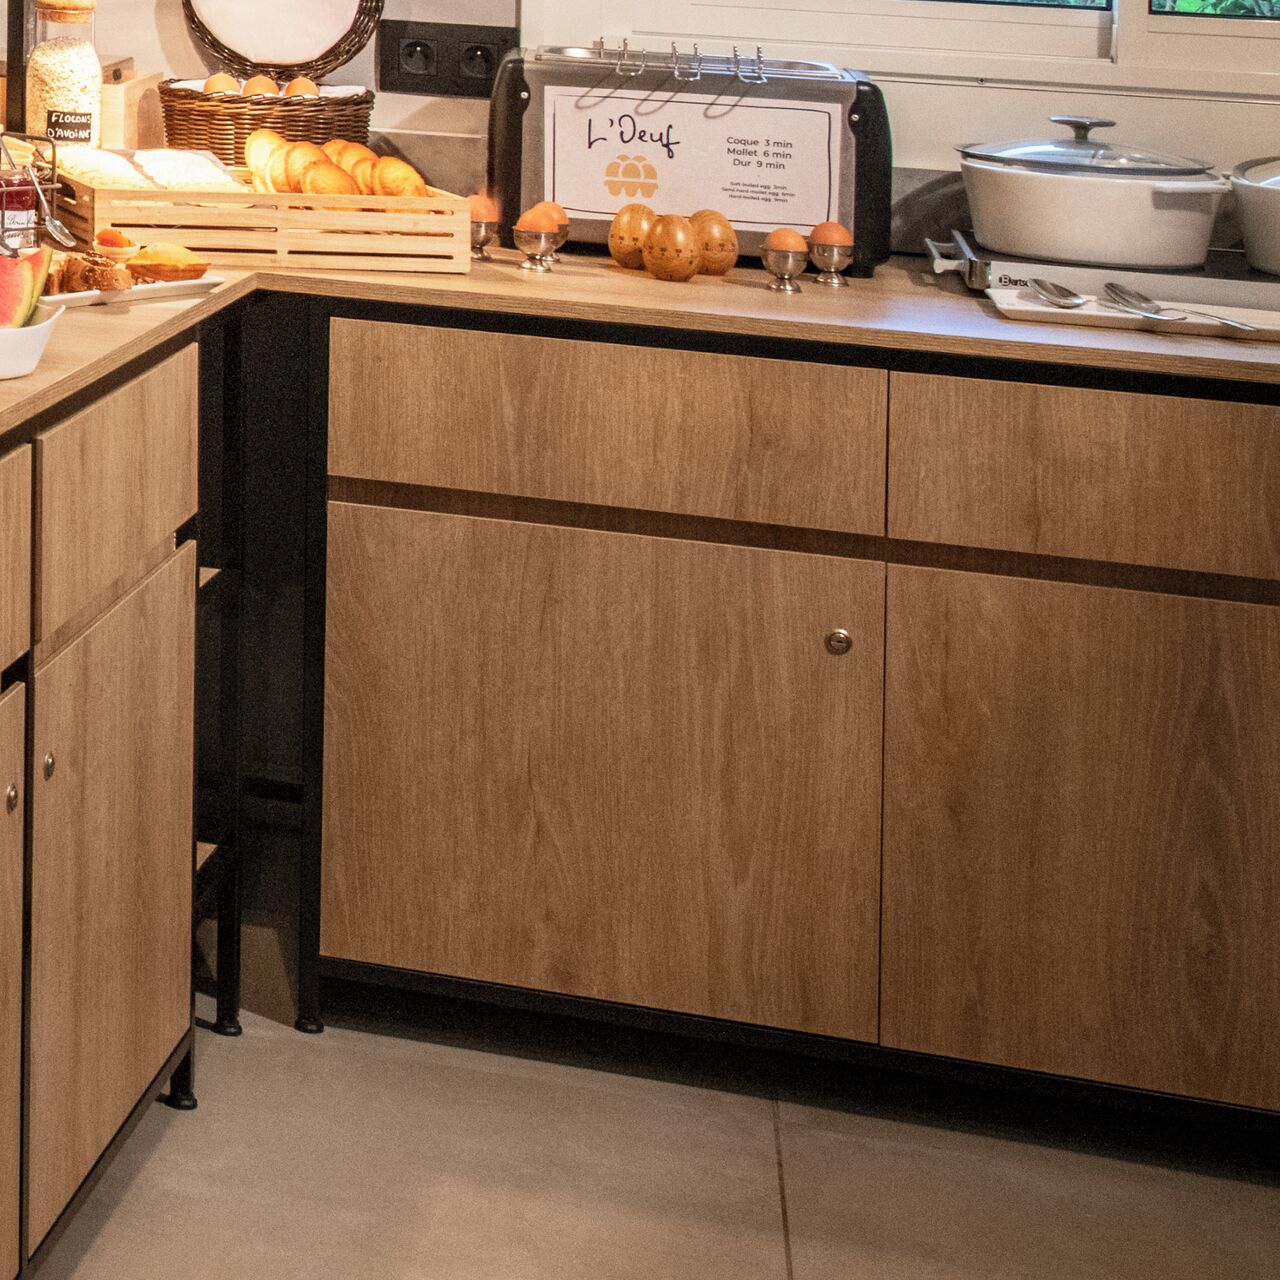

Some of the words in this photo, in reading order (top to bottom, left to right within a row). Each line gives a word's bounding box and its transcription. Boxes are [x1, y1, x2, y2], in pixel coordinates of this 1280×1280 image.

[51, 112, 91, 123] FLOCONS
[726, 136, 759, 147] Coque
[764, 139, 770, 147] 3
[773, 140, 793, 149] min
[726, 147, 757, 157] Mollet
[763, 150, 770, 158] 6
[772, 151, 792, 159] min
[733, 158, 751, 167] Dur
[756, 160, 763, 168] 9
[766, 161, 785, 169] min
